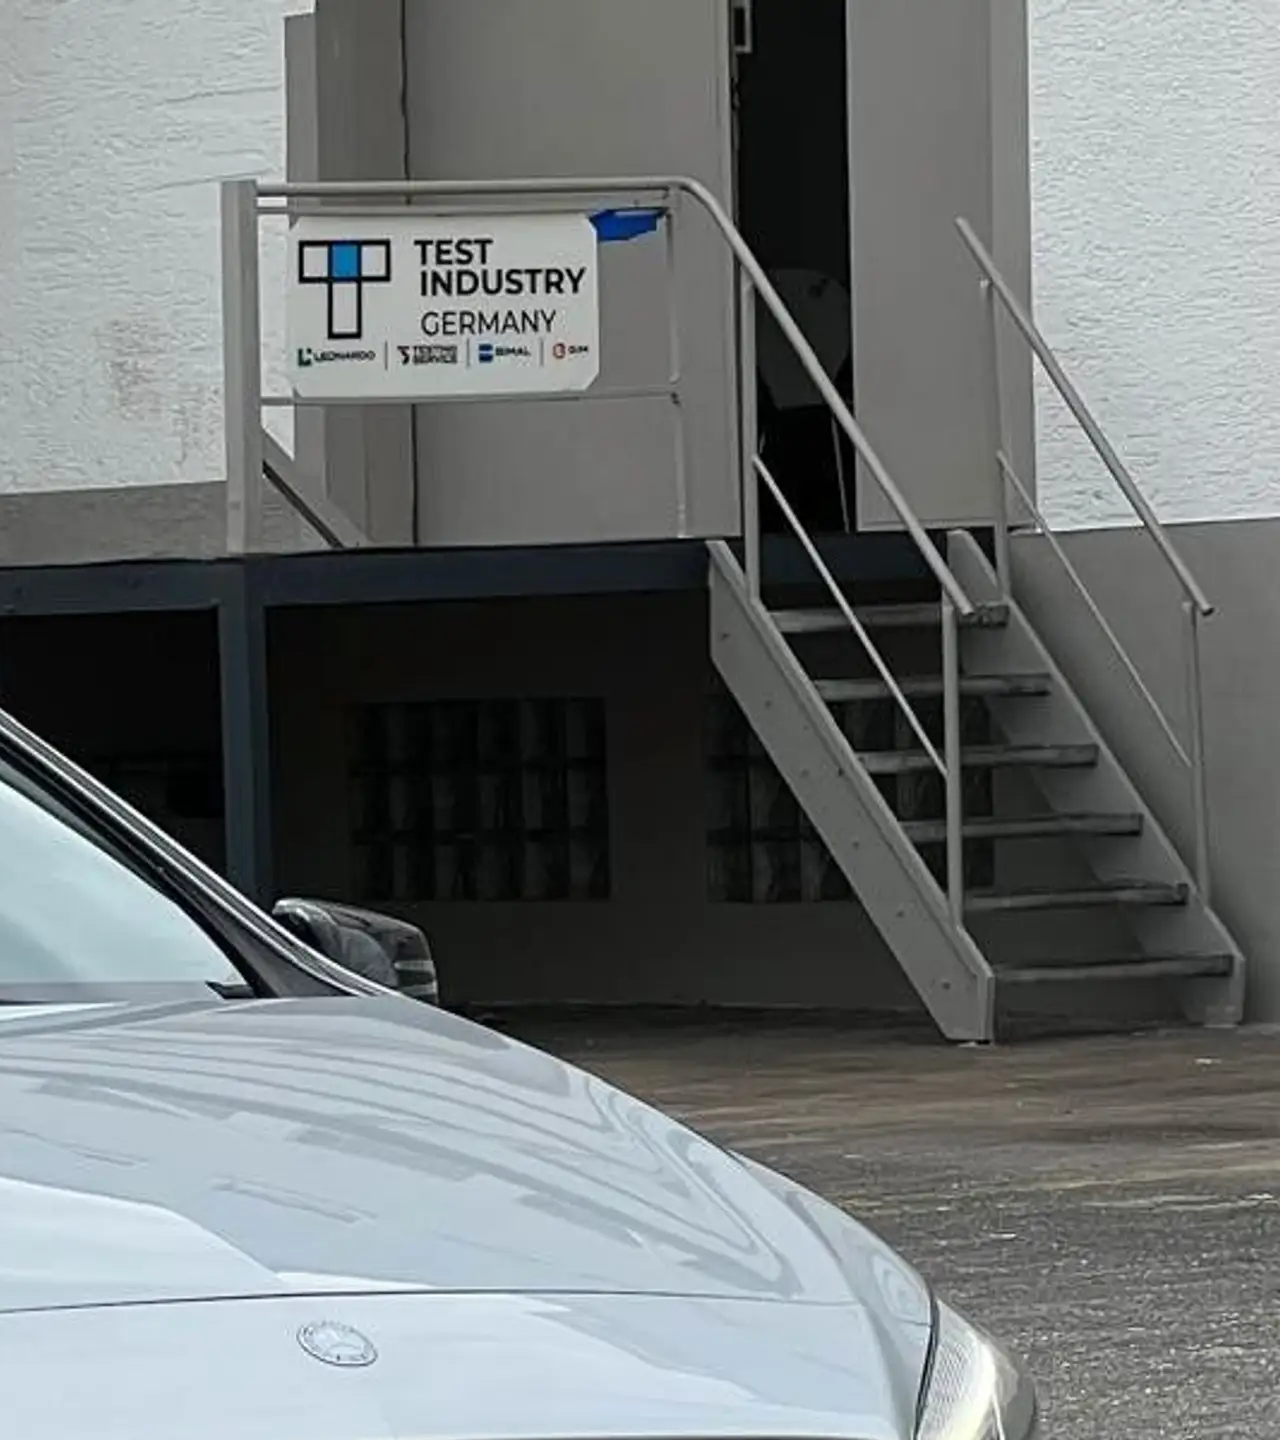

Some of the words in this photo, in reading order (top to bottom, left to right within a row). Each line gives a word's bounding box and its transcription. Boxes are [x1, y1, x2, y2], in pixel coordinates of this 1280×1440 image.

[413, 238, 494, 266] TEST
[420, 267, 586, 297] INDUSTRY
[421, 309, 557, 337] GERMANY
